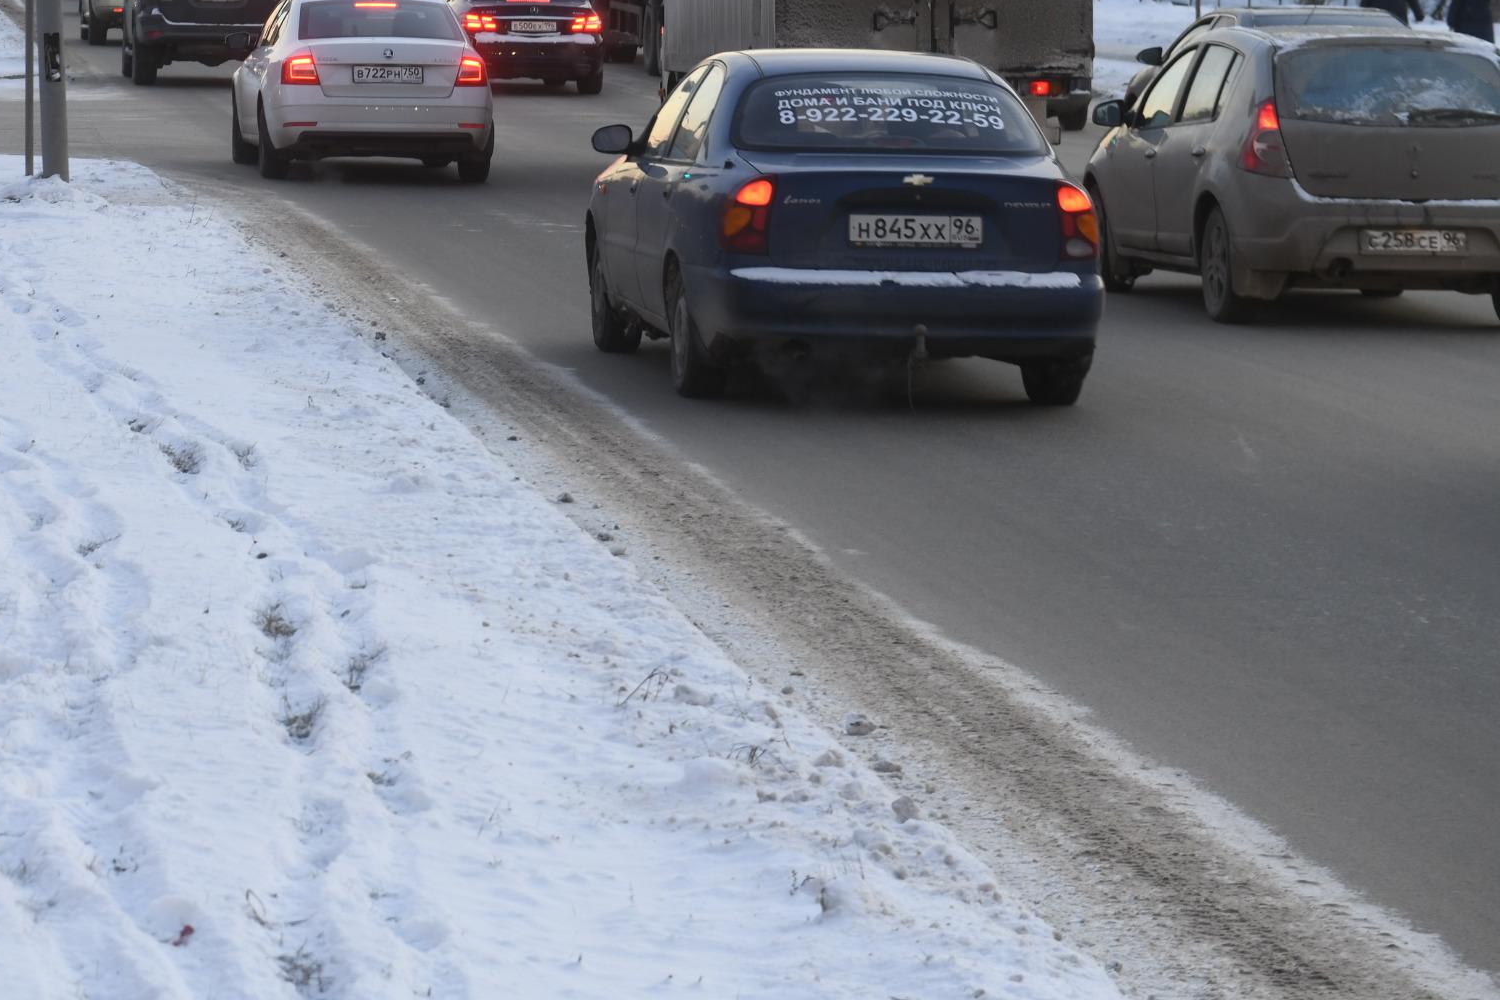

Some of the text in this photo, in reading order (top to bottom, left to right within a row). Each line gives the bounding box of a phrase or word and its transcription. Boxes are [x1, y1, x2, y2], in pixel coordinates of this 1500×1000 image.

[357, 67, 419, 78] В722РН 750
[775, 88, 855, 97] ФУНДАМЕНТ
[915, 89, 998, 103] СЛОЖНОСТИ
[778, 96, 1001, 115] ДОМА И БАНИ ПОД КЛЮЧ
[779, 107, 1004, 130] 8-922-229-22-59
[858, 218, 975, 240] Н845ХХ 96
[1368, 231, 1461, 249] С258СЕ 96
